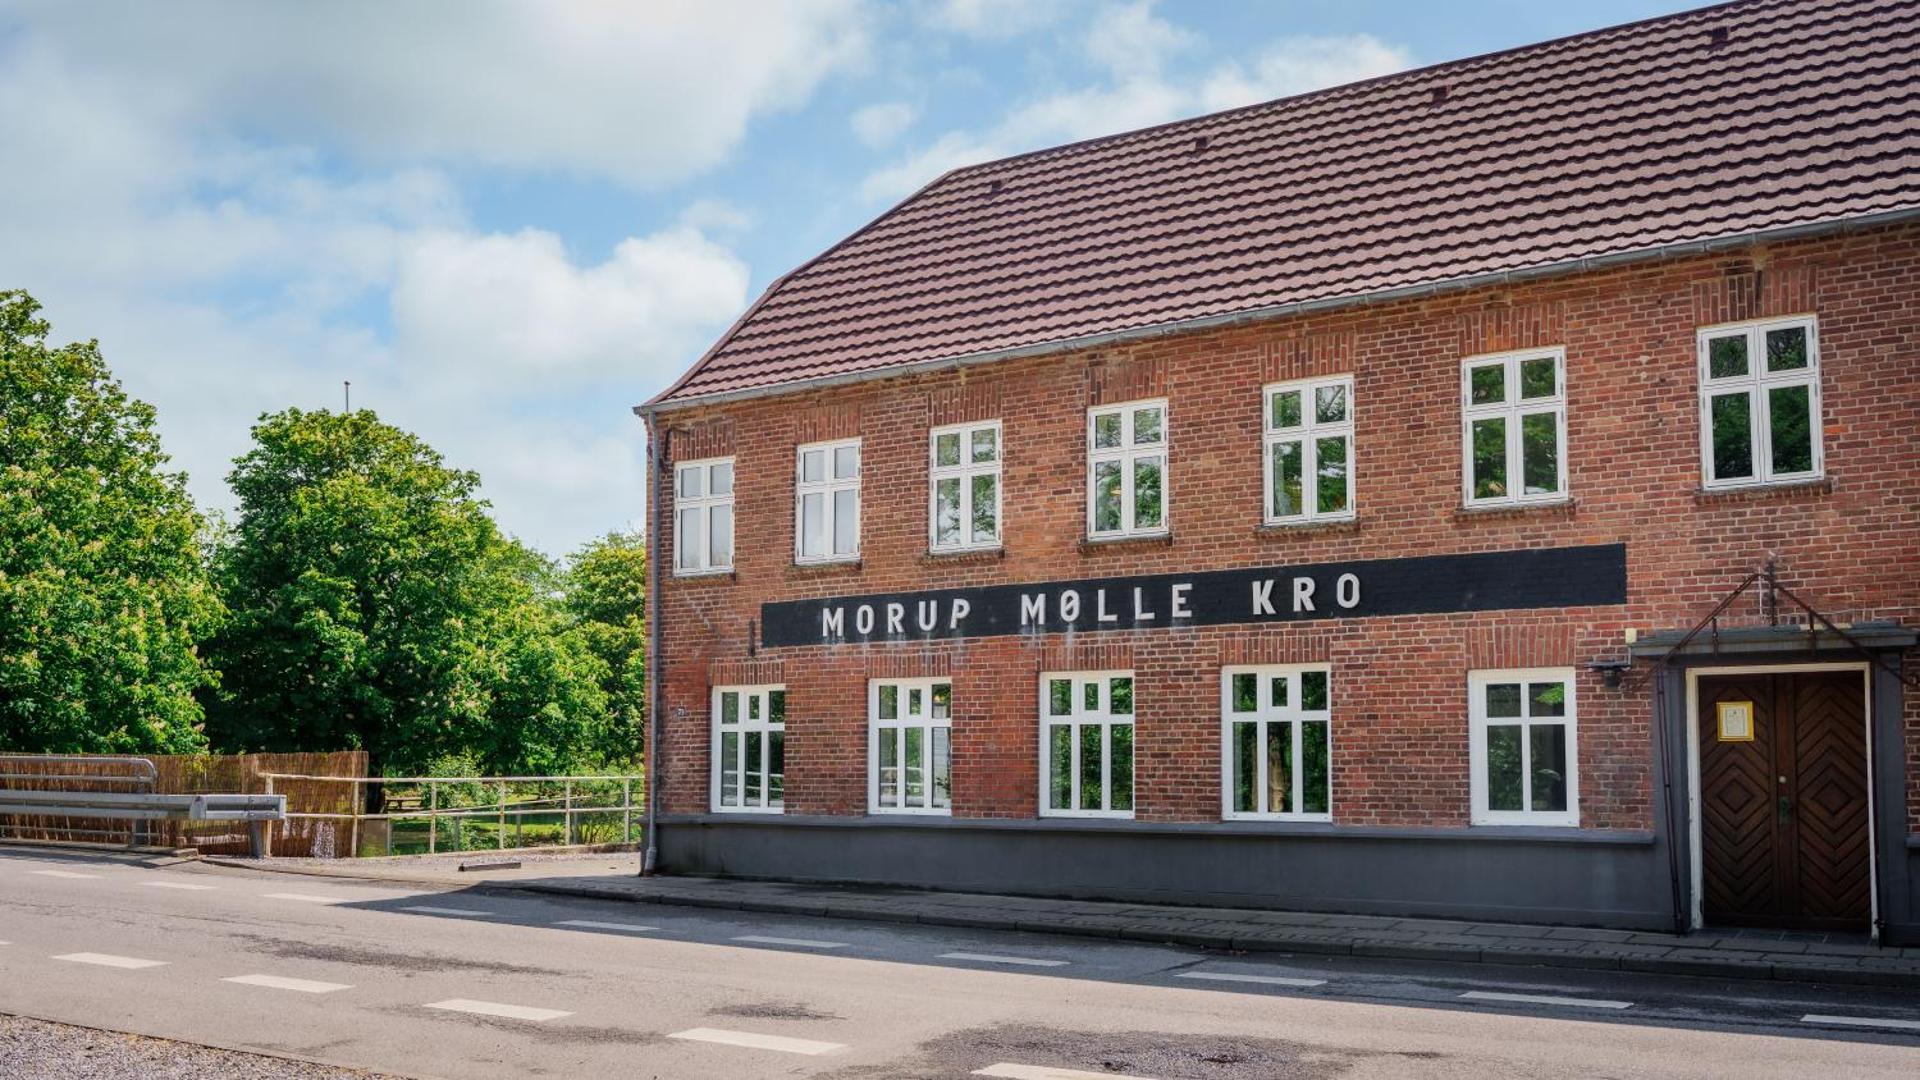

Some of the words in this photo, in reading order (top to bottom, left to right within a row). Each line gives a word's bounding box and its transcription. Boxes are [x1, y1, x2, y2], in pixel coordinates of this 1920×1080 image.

[822, 598, 971, 637] MORUP
[1021, 583, 1193, 626] MØLLE
[1252, 572, 1360, 615] KRO
